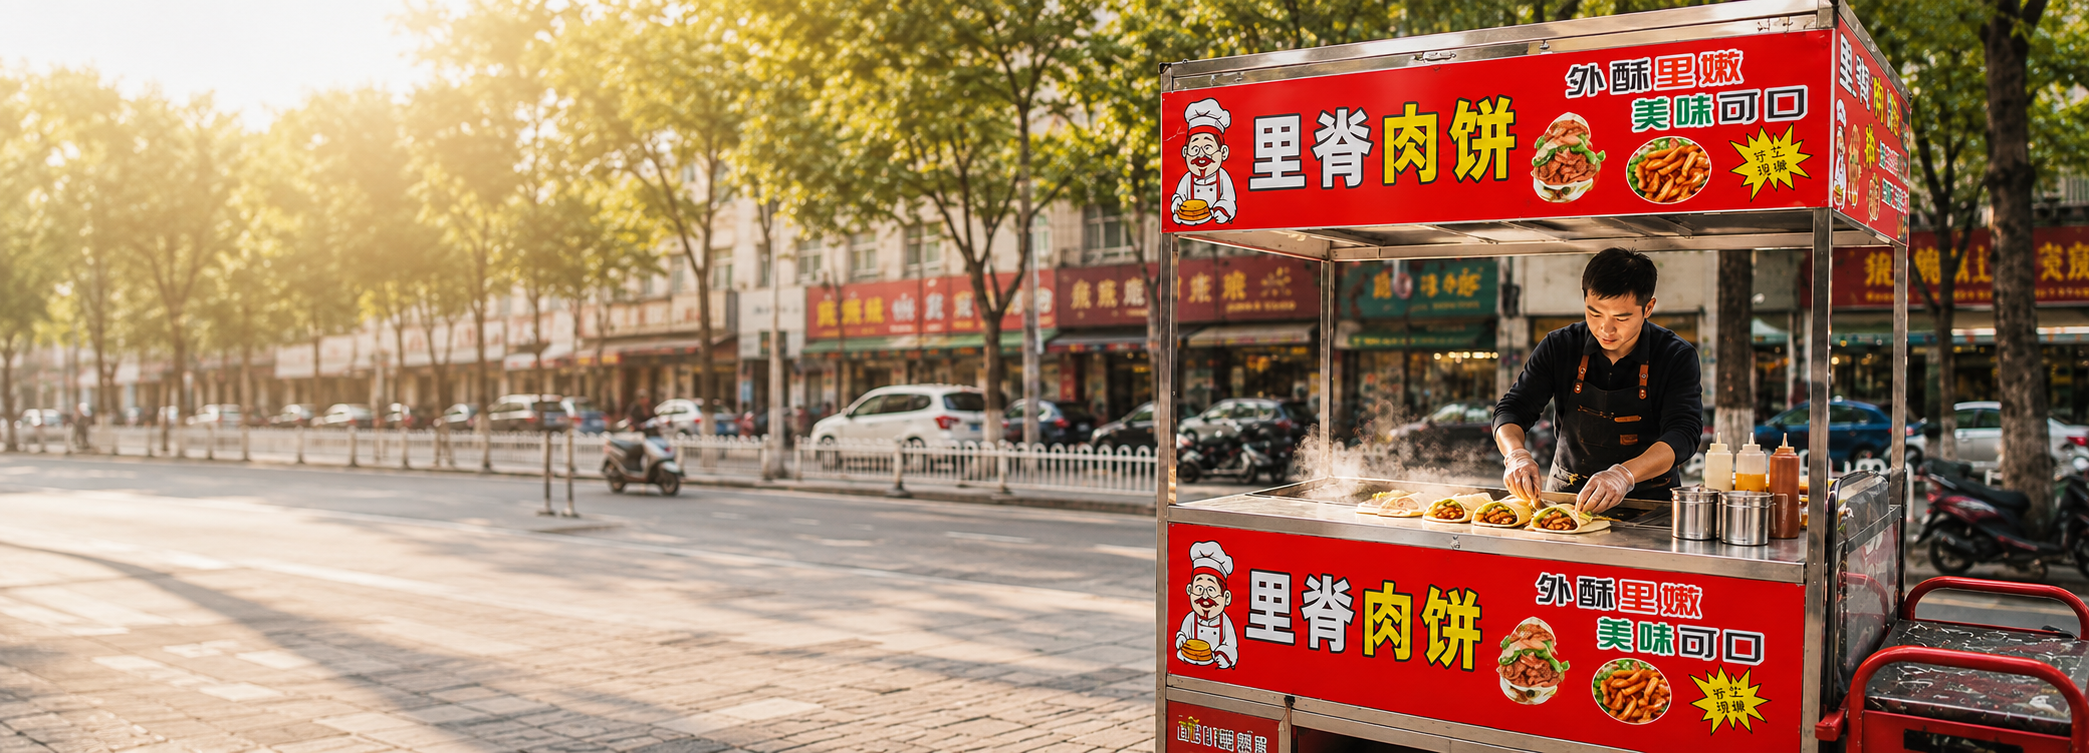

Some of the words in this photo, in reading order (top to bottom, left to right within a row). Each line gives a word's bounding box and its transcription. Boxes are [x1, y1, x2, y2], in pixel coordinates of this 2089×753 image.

[1565, 49, 1744, 99] 外酥里嫩
[1631, 85, 1809, 133] 美味可口
[1248, 94, 1517, 192] 里脊肉饼
[1244, 568, 1483, 672] 里脊肉饼
[1535, 572, 1703, 620] 外酥里嫩
[1596, 616, 1765, 666] 美味可口
